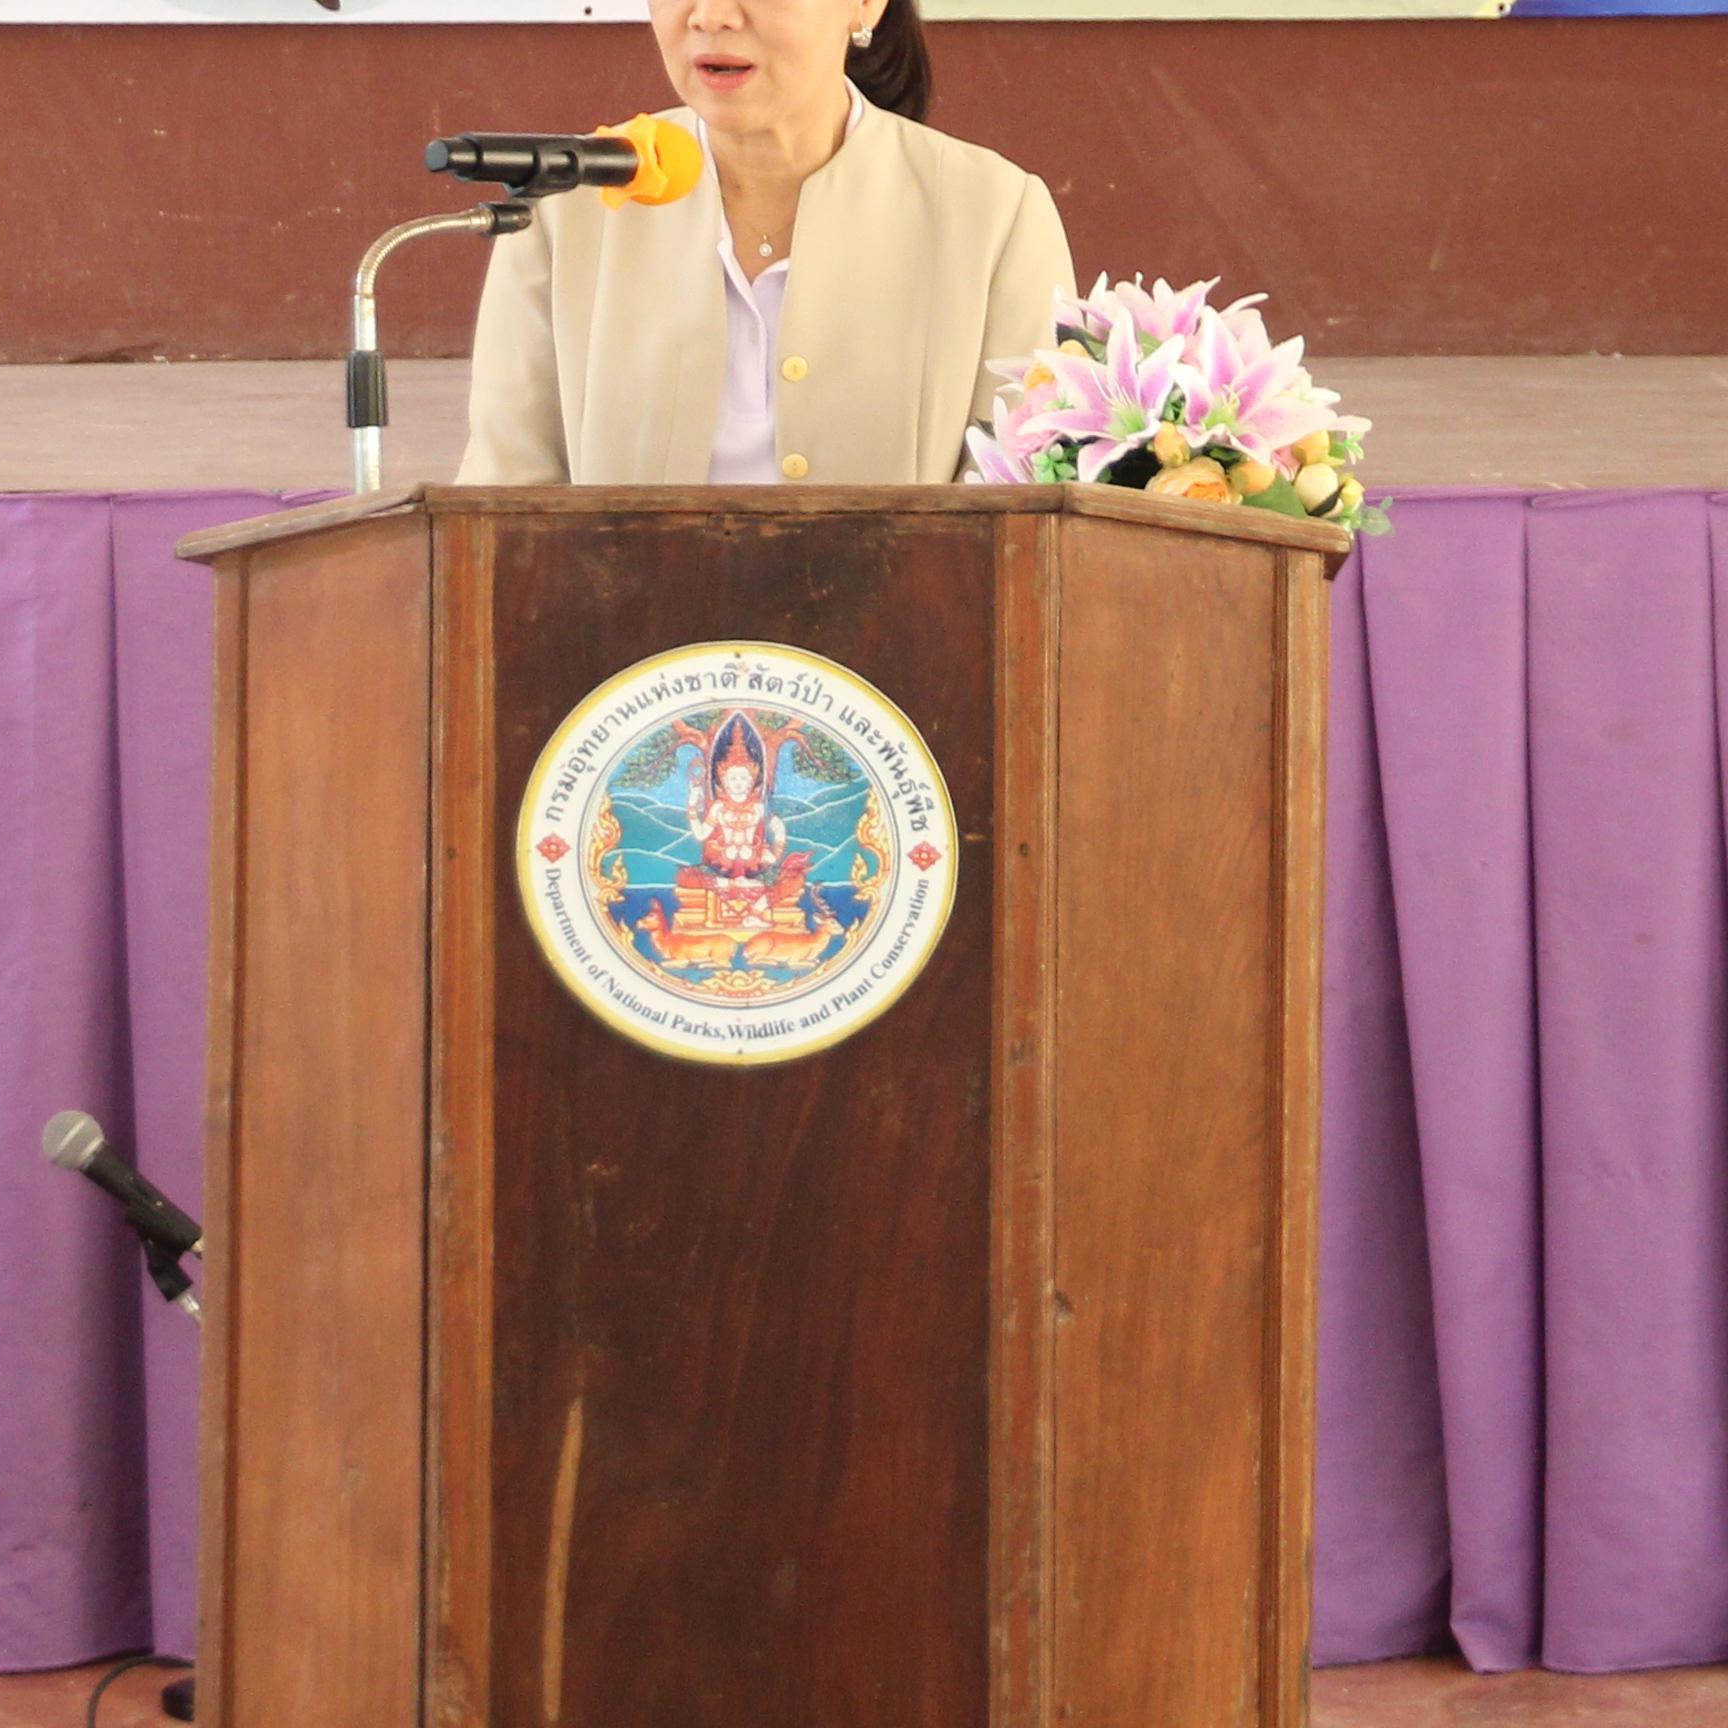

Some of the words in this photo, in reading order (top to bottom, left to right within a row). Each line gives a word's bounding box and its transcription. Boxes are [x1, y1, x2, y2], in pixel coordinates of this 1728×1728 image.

[544, 662, 740, 822] กรมอุทยานแห่งชาติ
[746, 664, 836, 712] สัตว์ป่า
[544, 867, 591, 964] Department
[586, 962, 607, 981] of
[602, 974, 669, 1027] National
[799, 1003, 831, 1028] and
[832, 975, 874, 1013] Plant
[872, 877, 930, 980] Conservation
